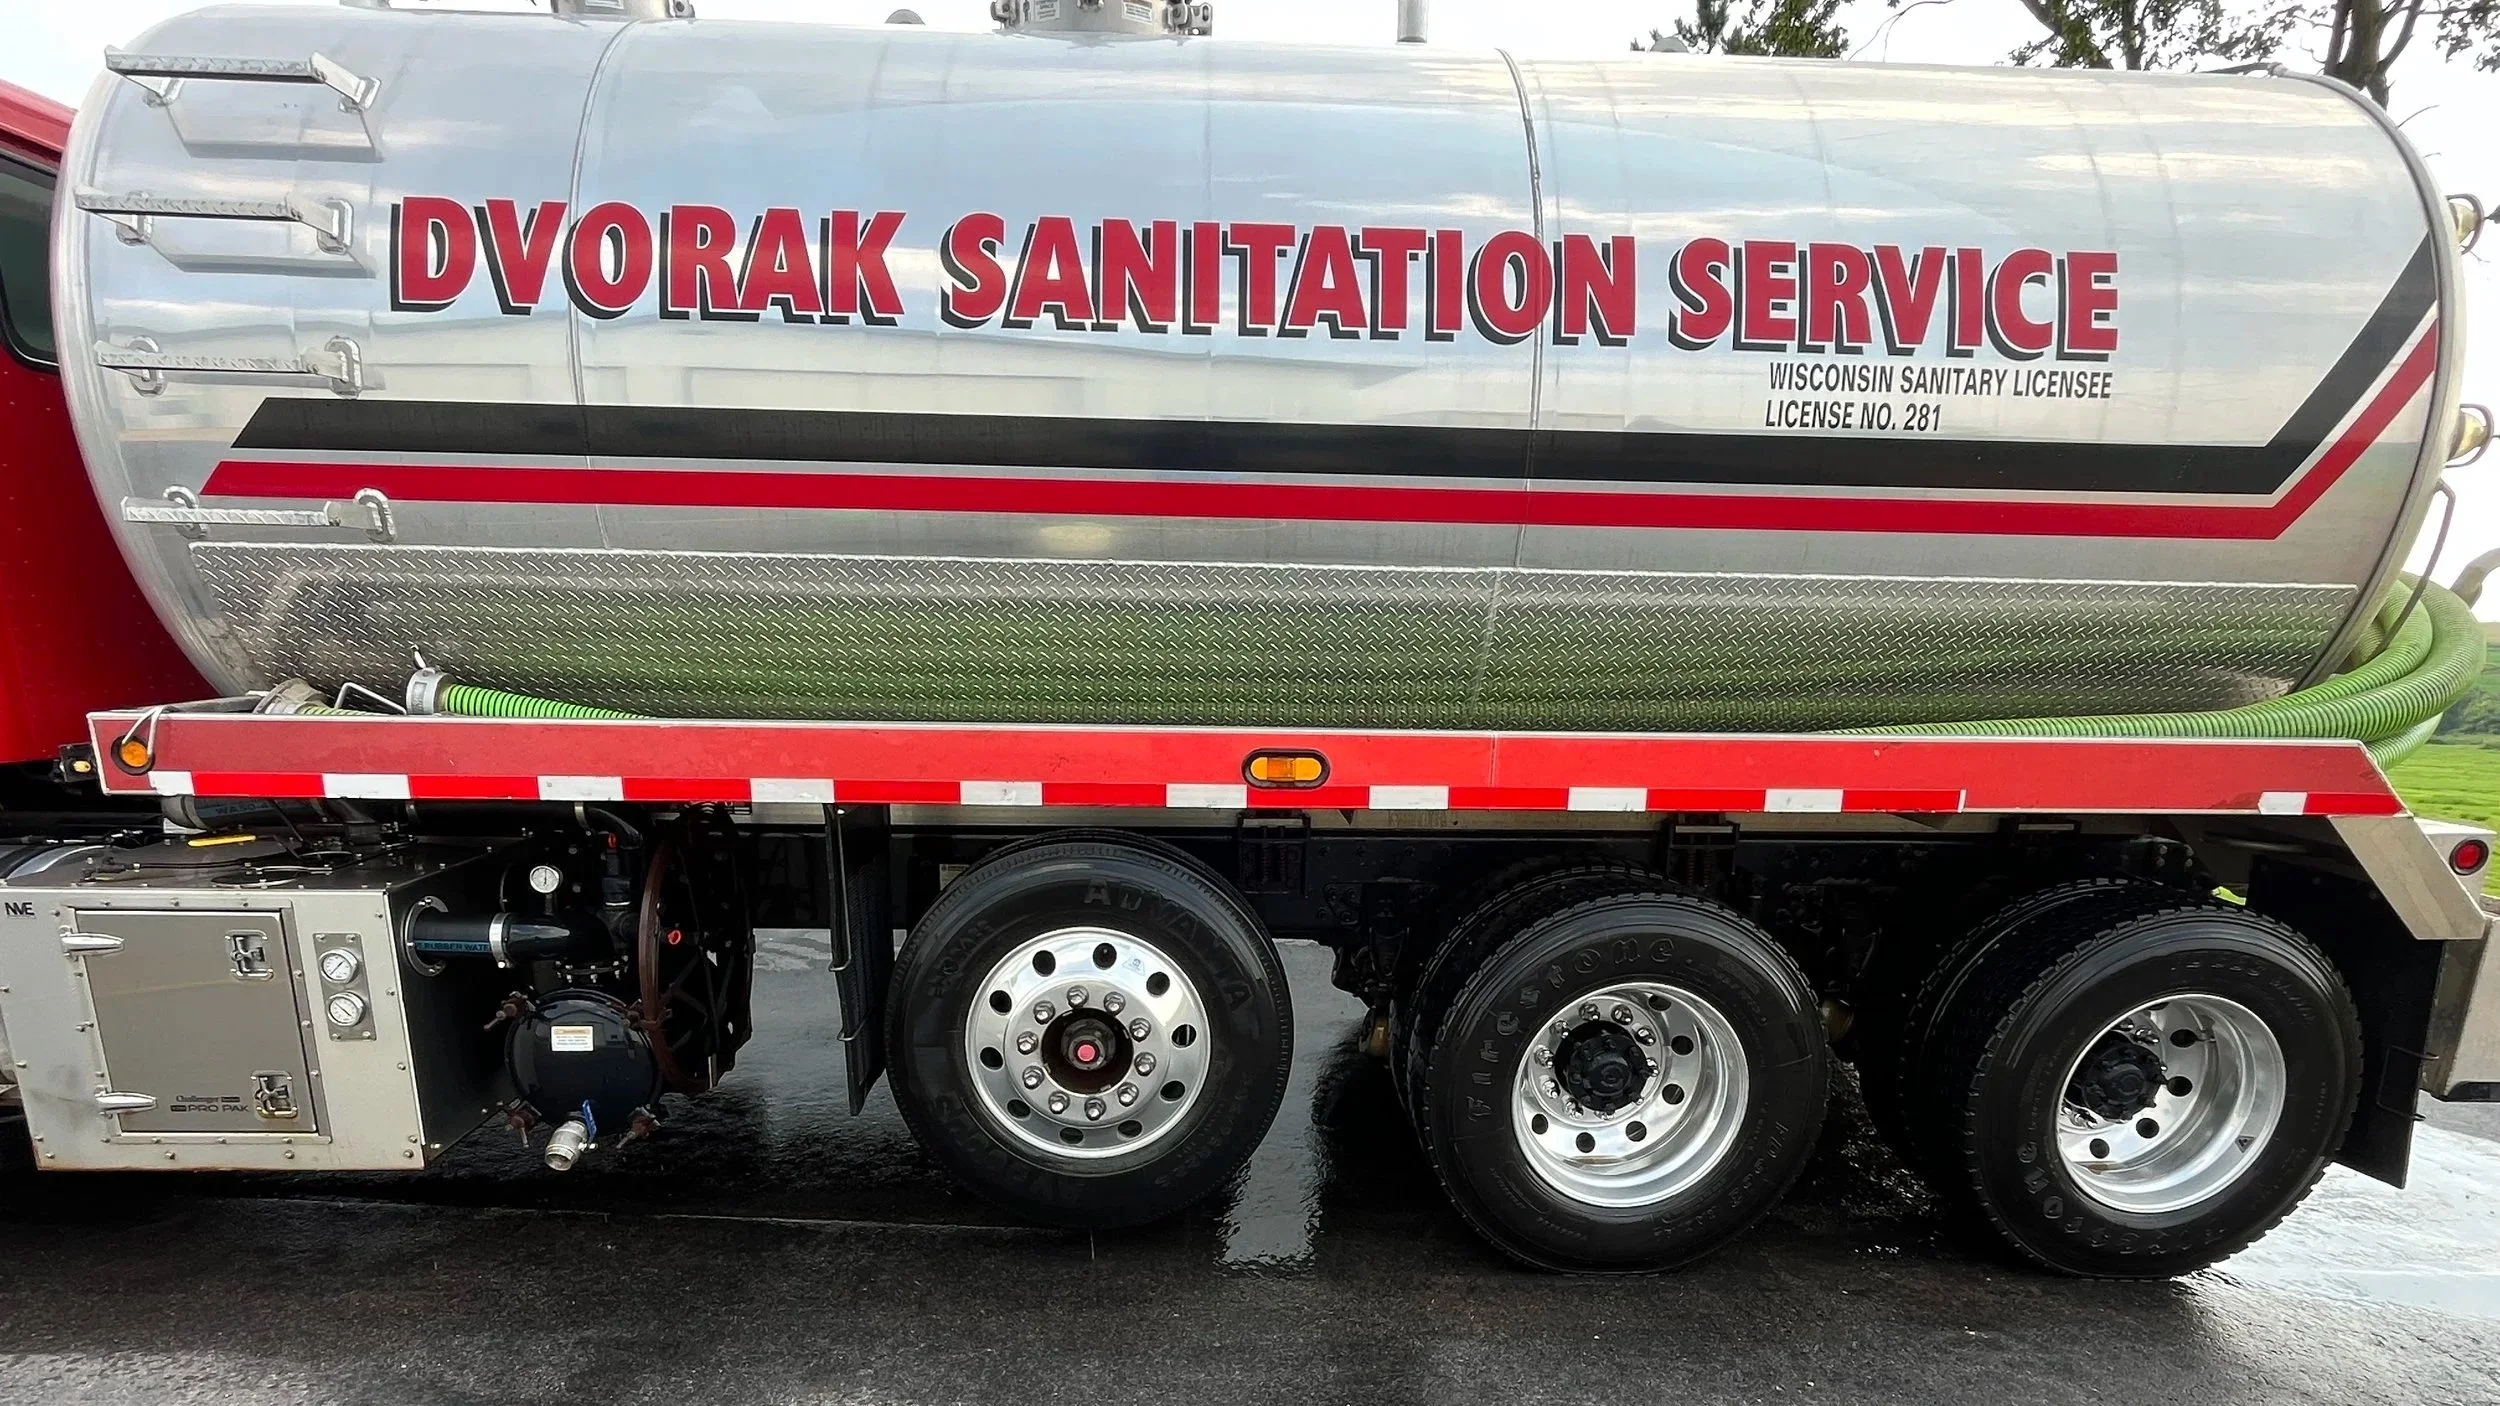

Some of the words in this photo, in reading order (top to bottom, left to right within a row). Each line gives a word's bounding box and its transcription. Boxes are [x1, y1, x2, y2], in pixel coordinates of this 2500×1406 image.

[390, 195, 907, 327] DVORAK
[939, 211, 1637, 347] SANITATION
[1668, 237, 2120, 362] SERVICE
[1768, 361, 1895, 393] WISCONSIN
[1899, 365, 2009, 397] SANITARY
[2012, 368, 2114, 400] LICENSEE
[1764, 399, 1855, 430] LICENSE
[1859, 402, 1897, 431] NO.
[1902, 402, 1943, 432] 281
[4, 902, 35, 916] NVE
[465, 943, 493, 952] WATE
[188, 1105, 219, 1113] PRO
[222, 1105, 249, 1113] PAK
